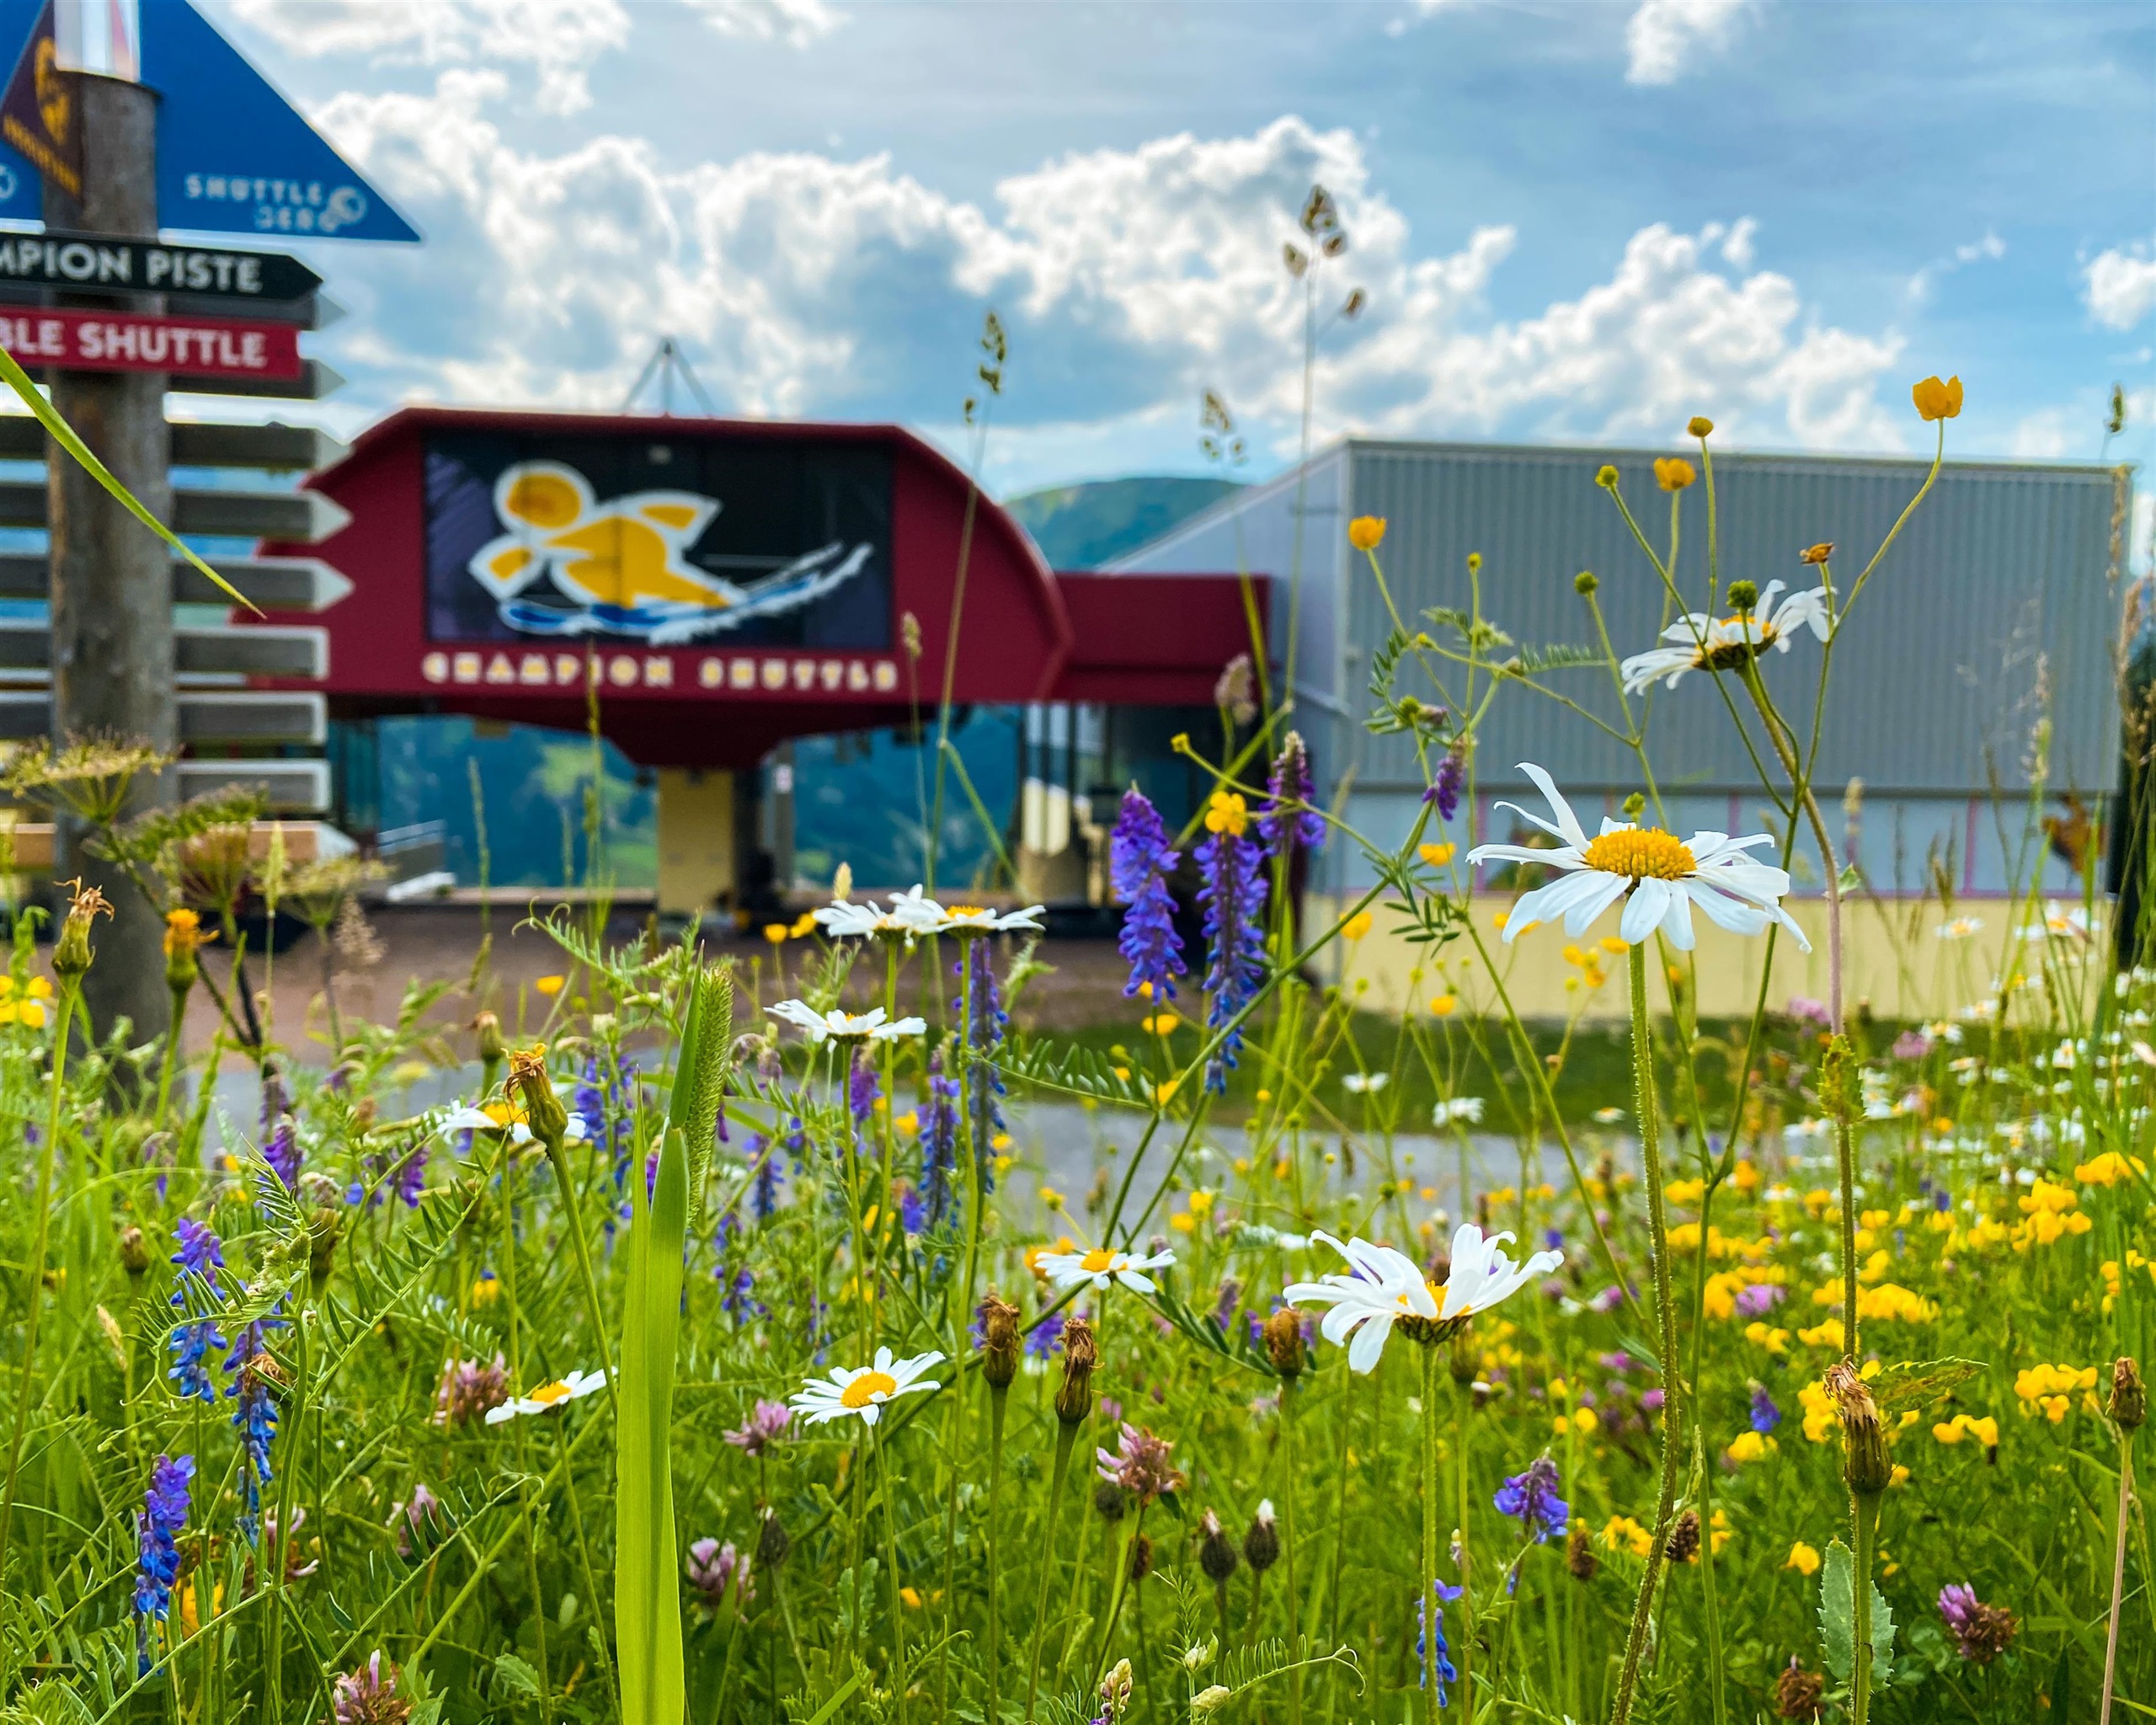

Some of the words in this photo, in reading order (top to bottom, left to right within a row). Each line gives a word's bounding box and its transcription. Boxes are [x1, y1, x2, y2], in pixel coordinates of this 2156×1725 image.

[184, 173, 323, 207] SHUTTLE
[146, 248, 264, 294] PISTE
[77, 320, 269, 369] SHUTTLE
[422, 650, 673, 689] CHAMPION
[698, 655, 898, 692] SHUTTLE
